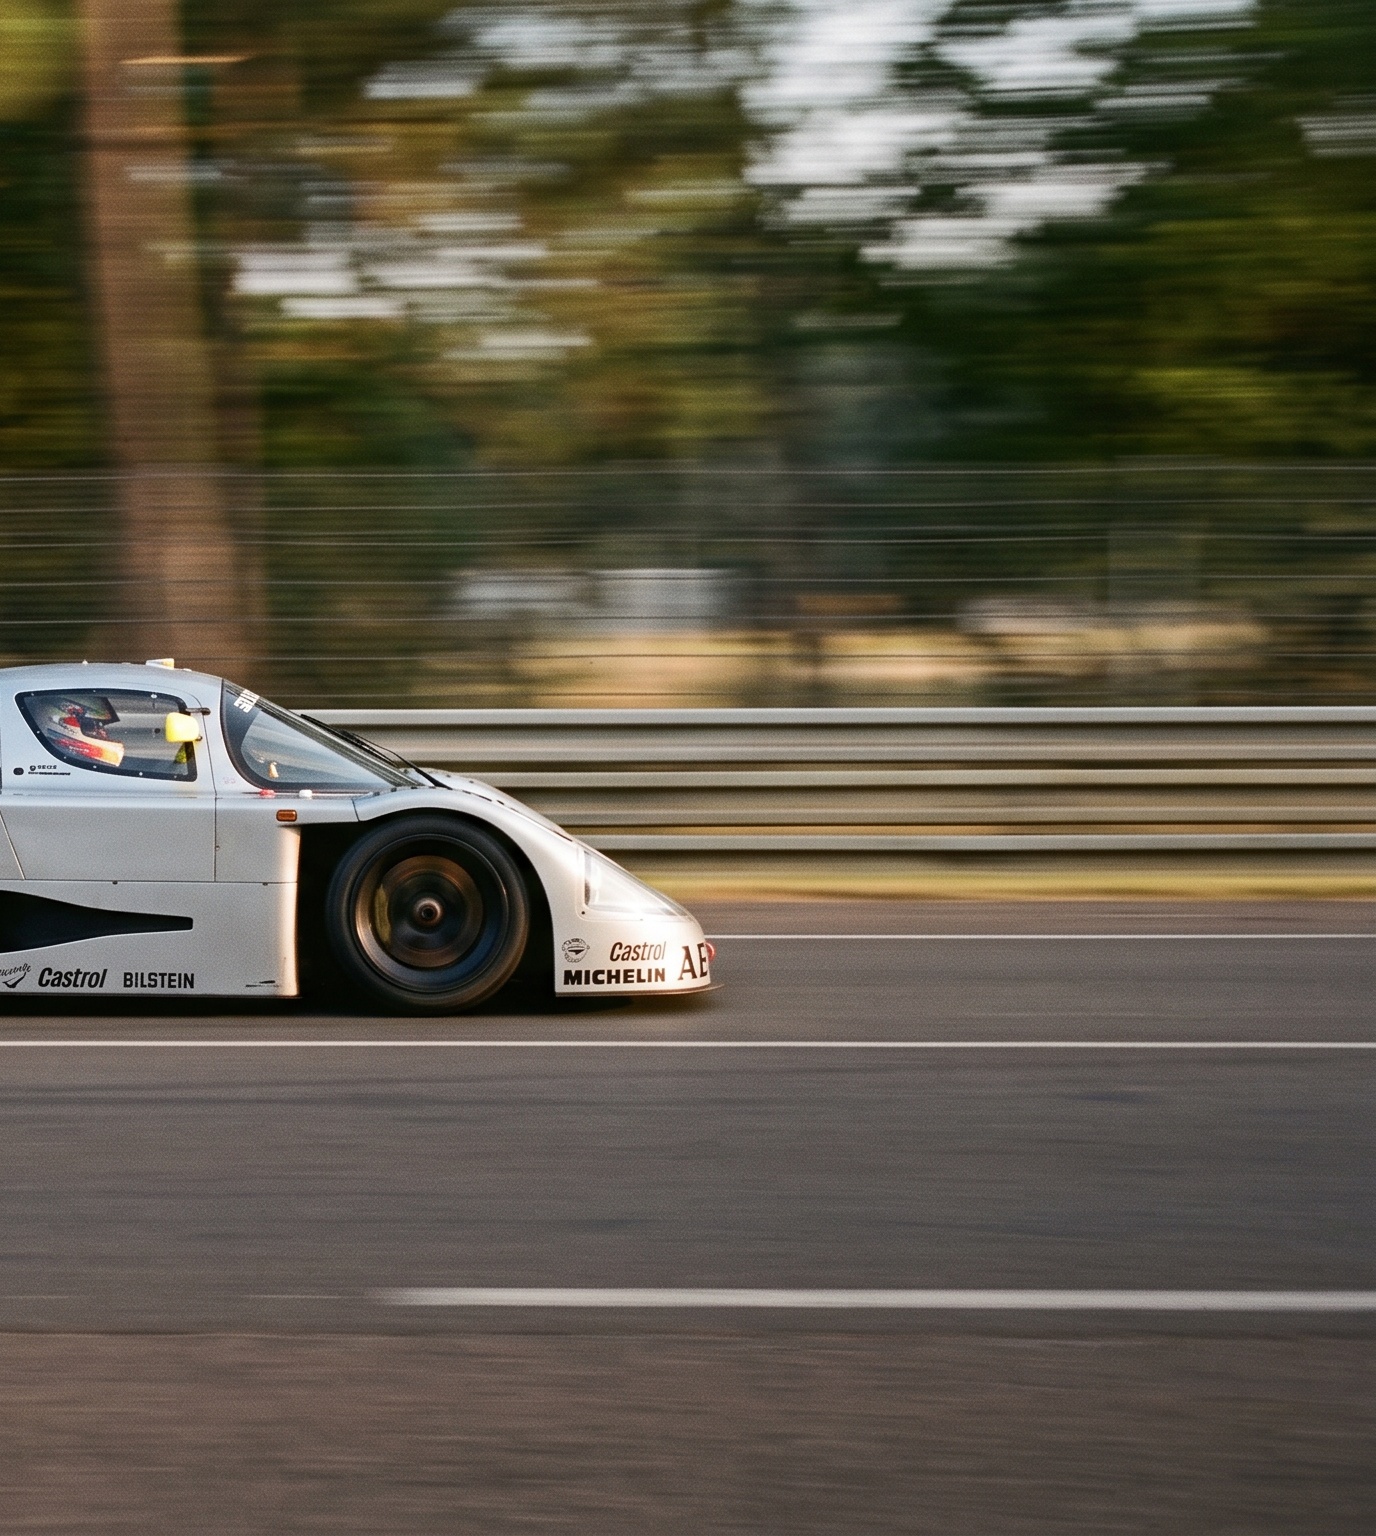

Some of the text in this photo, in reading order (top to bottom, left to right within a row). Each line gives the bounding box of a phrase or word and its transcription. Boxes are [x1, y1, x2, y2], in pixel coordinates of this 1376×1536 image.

[609, 940, 667, 962] Castrol
[37, 967, 108, 988] Castrol
[123, 971, 195, 989] BILSTEIN
[563, 967, 666, 986] MICHELIN
